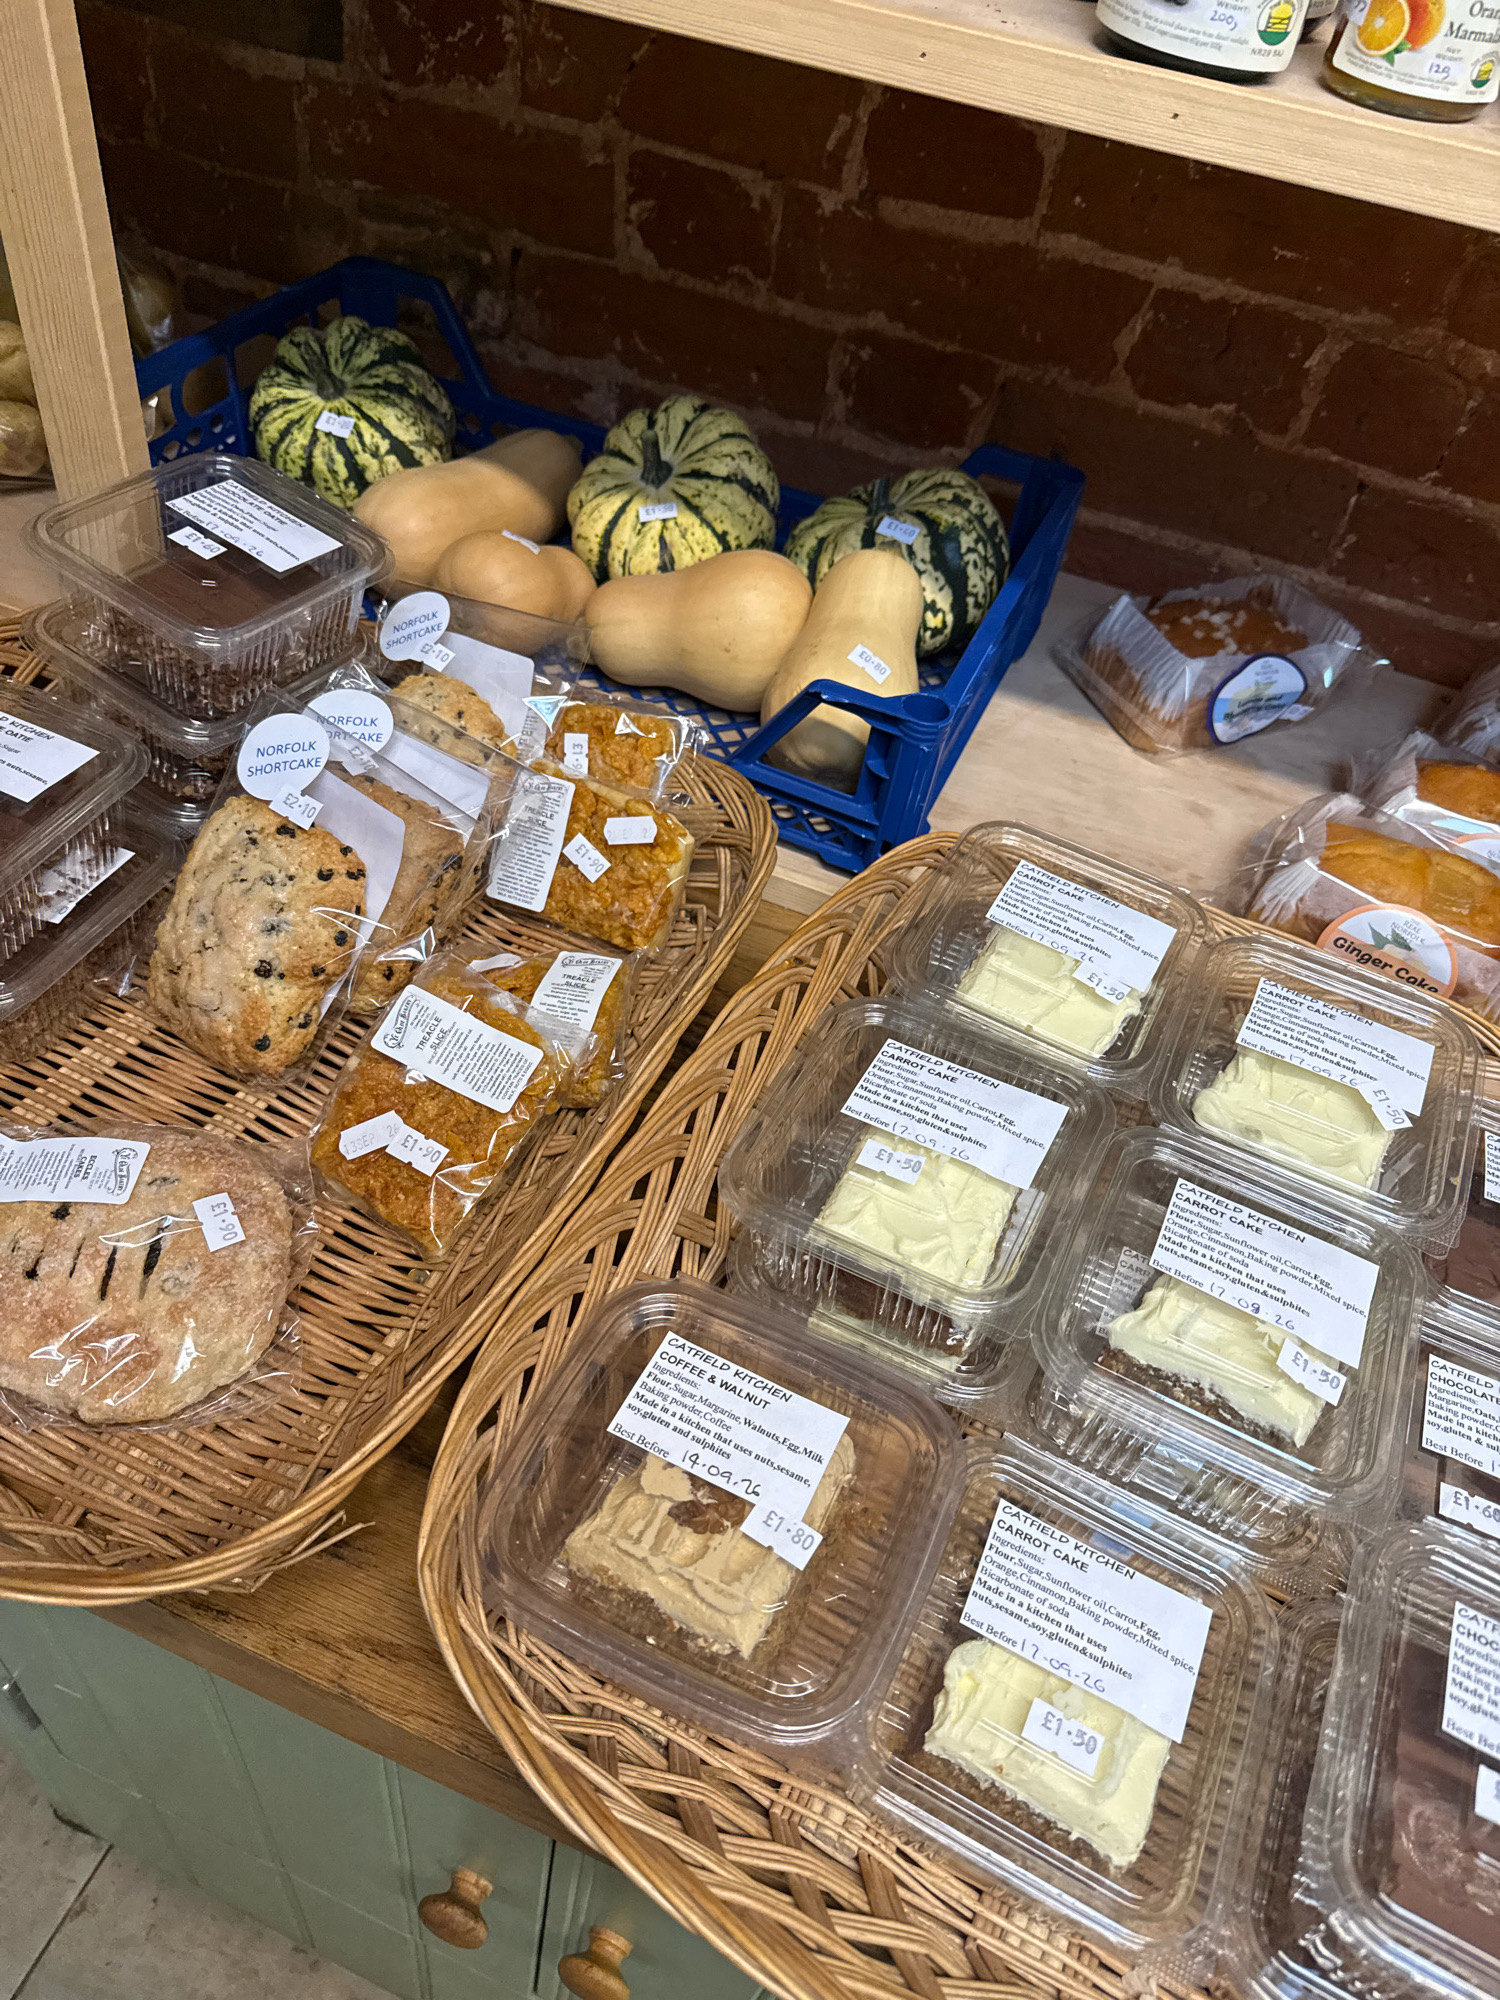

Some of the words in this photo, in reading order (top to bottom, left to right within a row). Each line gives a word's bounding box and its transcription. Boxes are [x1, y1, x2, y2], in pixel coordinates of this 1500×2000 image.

[217, 484, 264, 511] CHOCOLATE
[267, 505, 305, 527] KITCHEN
[386, 622, 443, 649] SHORTCAKE
[392, 610, 439, 634] NORFOLK
[4, 728, 34, 743] OATIE
[9, 720, 55, 741] KITCHEN
[316, 715, 378, 727] NORFOLK
[256, 741, 317, 758] NORFOLK
[247, 757, 322, 777] SHORTCAKE
[524, 804, 555, 821] TREACLE
[1016, 870, 1056, 889] CARROT
[1057, 887, 1084, 901] CAKE
[1020, 863, 1071, 887] CATFIELD
[1073, 886, 1119, 908] KITCHEN
[1402, 920, 1421, 934] REAL
[562, 974, 596, 983] TREACLE
[1333, 936, 1393, 968] Ginger
[1395, 968, 1439, 993] Cake
[1259, 987, 1304, 1007] CARROT
[1306, 1005, 1336, 1020] CAKE
[1262, 979, 1318, 1003] CATFIELD
[1322, 1002, 1373, 1026] KITCHEN
[416, 1016, 442, 1051] TREACLE
[430, 1028, 448, 1051] SLICE
[1240, 1037, 1258, 1048] Best
[1259, 1045, 1285, 1059] Before
[876, 1057, 917, 1076] Ingredients:
[880, 1050, 926, 1070] CARROT
[927, 1068, 958, 1083] CAKE
[886, 1042, 943, 1066] CATFIELD
[946, 1064, 999, 1088] KITCHEN
[844, 1104, 862, 1116] Best
[863, 1112, 889, 1127] Before
[74, 1157, 87, 1178] CAKES
[82, 1155, 97, 1180] ECCLES
[1172, 1201, 1222, 1227] Ingredients:
[1175, 1192, 1226, 1218] CARROT
[1228, 1215, 1262, 1235] CAKE
[1178, 1182, 1243, 1213] CATFIELD
[1247, 1212, 1305, 1243] KITCHEN
[1152, 1258, 1172, 1272] Best
[1173, 1268, 1203, 1287] Before
[1161, 1233, 1187, 1250] Made
[1189, 1246, 1198, 1255] in
[1208, 1254, 1243, 1275] kitchen
[1245, 1272, 1264, 1285] that
[1266, 1282, 1286, 1295] uses
[1342, 1300, 1366, 1318] spice,
[652, 1361, 700, 1389] Ingredients:
[659, 1351, 707, 1379] COFFEE
[707, 1374, 716, 1384] &
[719, 1379, 770, 1409] WALNUT
[667, 1338, 730, 1370] CATFIELD
[733, 1369, 792, 1402] KITCHEN
[1431, 1360, 1494, 1389] CATFIELD
[1429, 1382, 1479, 1405] Ingredients:
[1430, 1372, 1500, 1405] CHOCOLATE
[639, 1380, 669, 1402] Baking
[668, 1397, 731, 1431] powder,Coffee
[1427, 1409, 1454, 1425] Made
[1456, 1419, 1465, 1429] in
[1428, 1400, 1459, 1417] Baking
[612, 1422, 635, 1440] Best
[635, 1434, 669, 1458] Before
[626, 1403, 670, 1428] soy,gluten
[671, 1425, 691, 1438] and
[690, 1435, 731, 1459] sulphites
[633, 1391, 659, 1408] Made
[659, 1404, 669, 1414] in
[678, 1413, 711, 1435] kitchen
[712, 1432, 732, 1446] that
[733, 1442, 752, 1456] uses
[753, 1453, 810, 1487] nuts,sesame,
[1475, 1437, 1484, 1446] &
[1425, 1437, 1448, 1453] Best
[1451, 1448, 1484, 1468] Before
[992, 1531, 1045, 1564] Ingredients:
[996, 1519, 1050, 1551] CARROT
[1052, 1548, 1089, 1573] CAKE
[1002, 1505, 1069, 1543] CATFIELD
[1073, 1542, 1135, 1579] KITCHEN
[988, 1543, 1091, 1601] Flour,Sugar,Sunflower
[980, 1565, 1034, 1599] Bicarbonate
[1035, 1596, 1047, 1606] of
[1047, 1602, 1069, 1618] soda
[962, 1611, 984, 1629] Best
[985, 1623, 1017, 1647] Before
[976, 1576, 1004, 1597] Made
[1005, 1592, 1015, 1603] in
[1017, 1600, 1024, 1608] a
[1026, 1603, 1062, 1628] kitchen
[1064, 1624, 1084, 1640] that
[1086, 1636, 1107, 1652] uses
[984, 1554, 1100, 1622] Orange,Cinnamon,Baking
[1102, 1617, 1169, 1658] powder,Mixed
[1169, 1654, 1195, 1676] spice,
